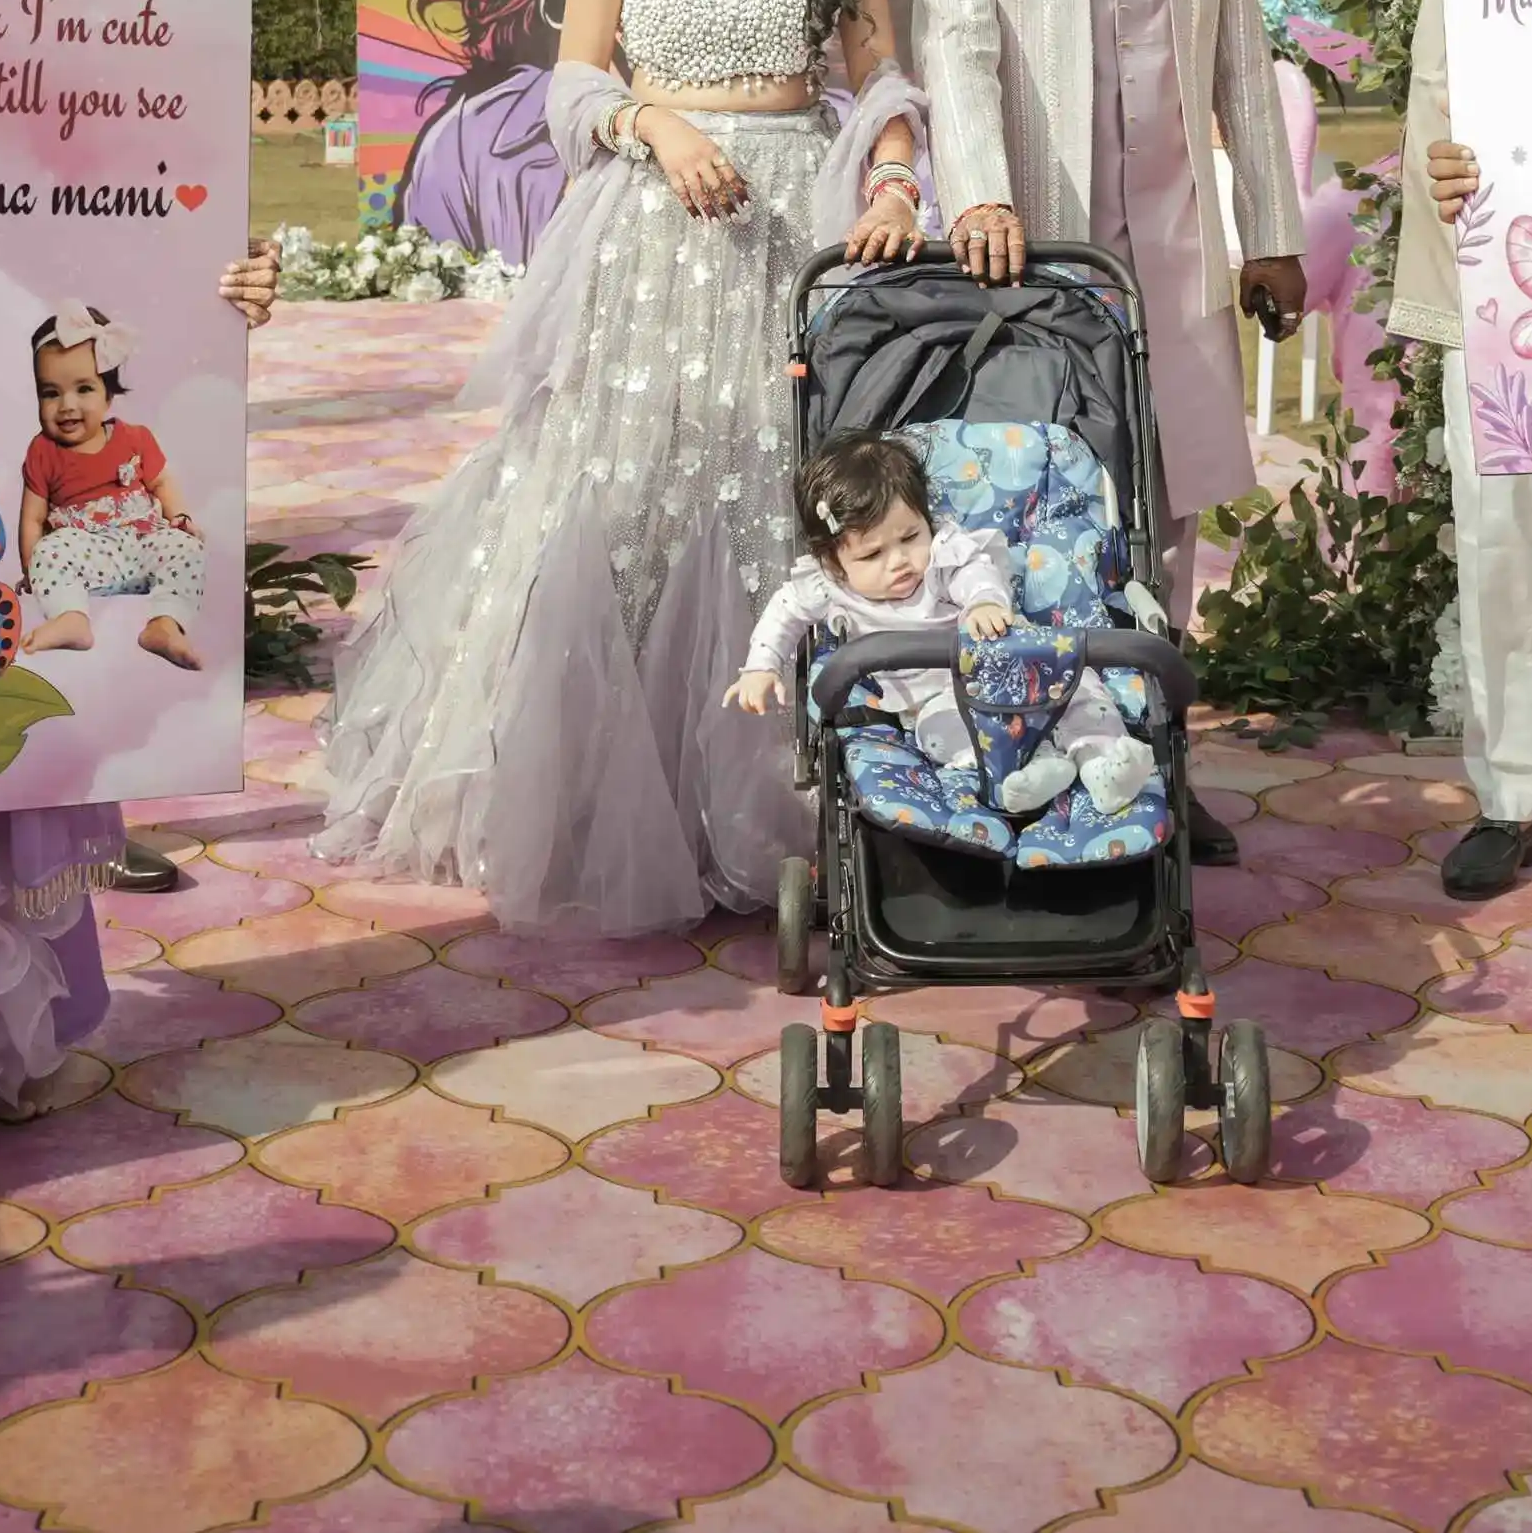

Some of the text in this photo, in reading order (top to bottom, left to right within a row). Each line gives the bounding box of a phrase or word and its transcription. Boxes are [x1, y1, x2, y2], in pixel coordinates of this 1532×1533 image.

[59, 91, 126, 141] you
[138, 87, 187, 120] see
[52, 161, 172, 217] mami
